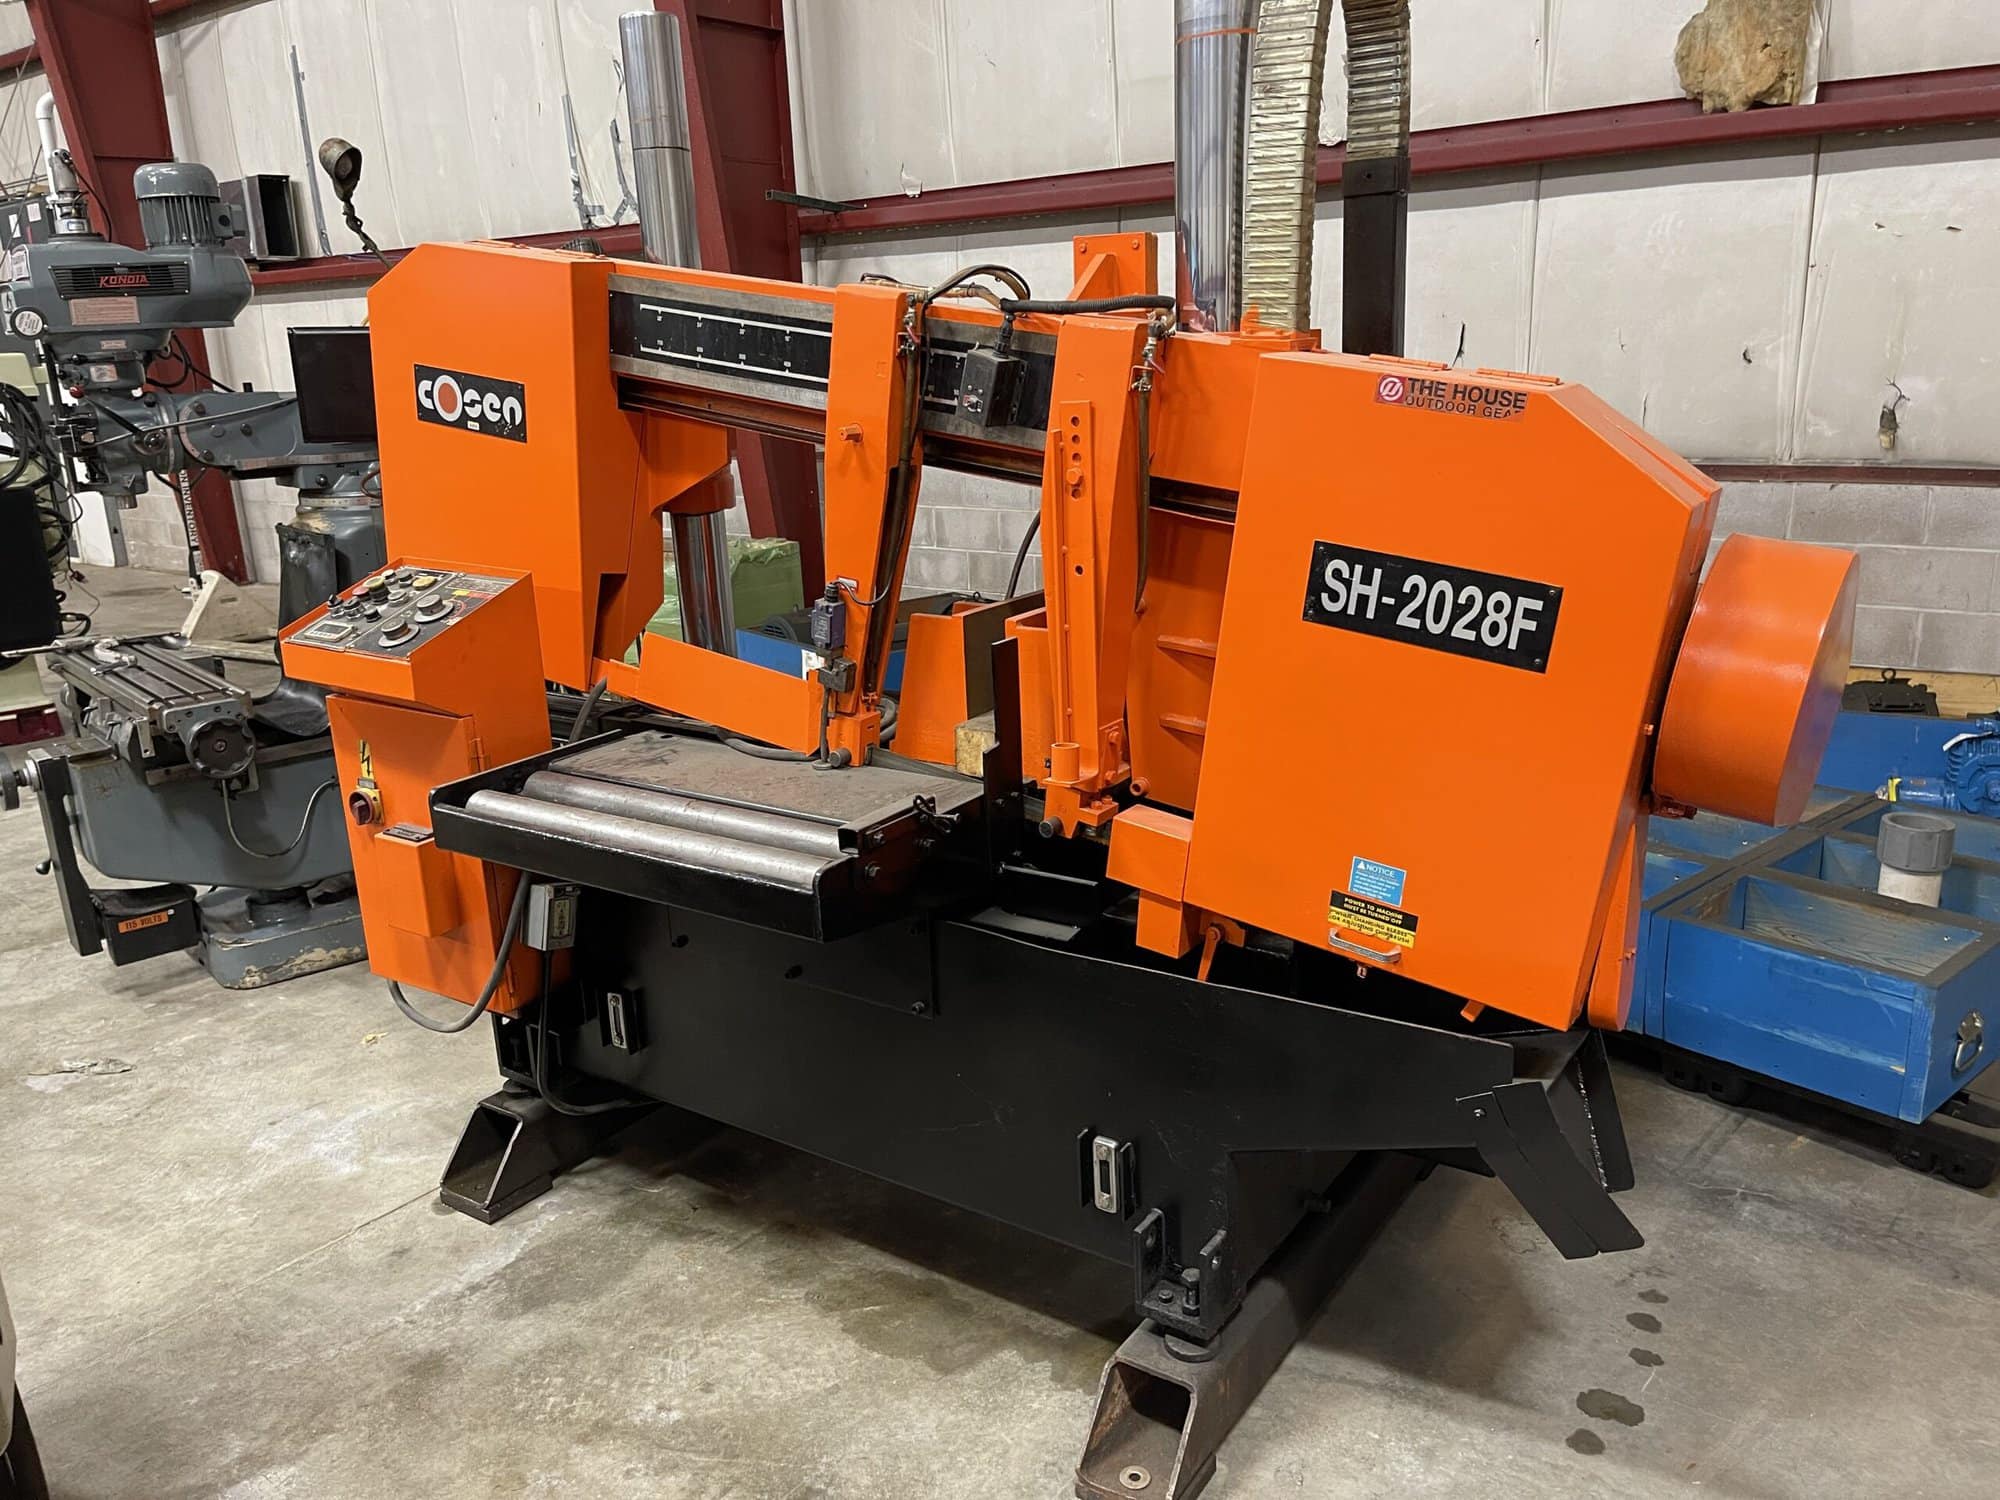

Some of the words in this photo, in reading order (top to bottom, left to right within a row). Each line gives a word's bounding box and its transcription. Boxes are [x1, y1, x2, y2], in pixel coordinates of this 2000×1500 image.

[99, 274, 150, 288] KONDIA
[1407, 377, 1447, 399] THE
[1452, 383, 1527, 410] HOUSE
[1405, 396, 1477, 416] OUTDOOR
[1482, 406, 1521, 419] GEA
[182, 485, 199, 544] INVENTORY
[1320, 558, 1544, 651] SH-2028F
[1366, 863, 1395, 878] NOTICE
[1344, 897, 1366, 908] POWER
[1376, 907, 1404, 920] MACHINE
[1367, 909, 1390, 922] TURNED
[1390, 917, 1403, 926] OFF
